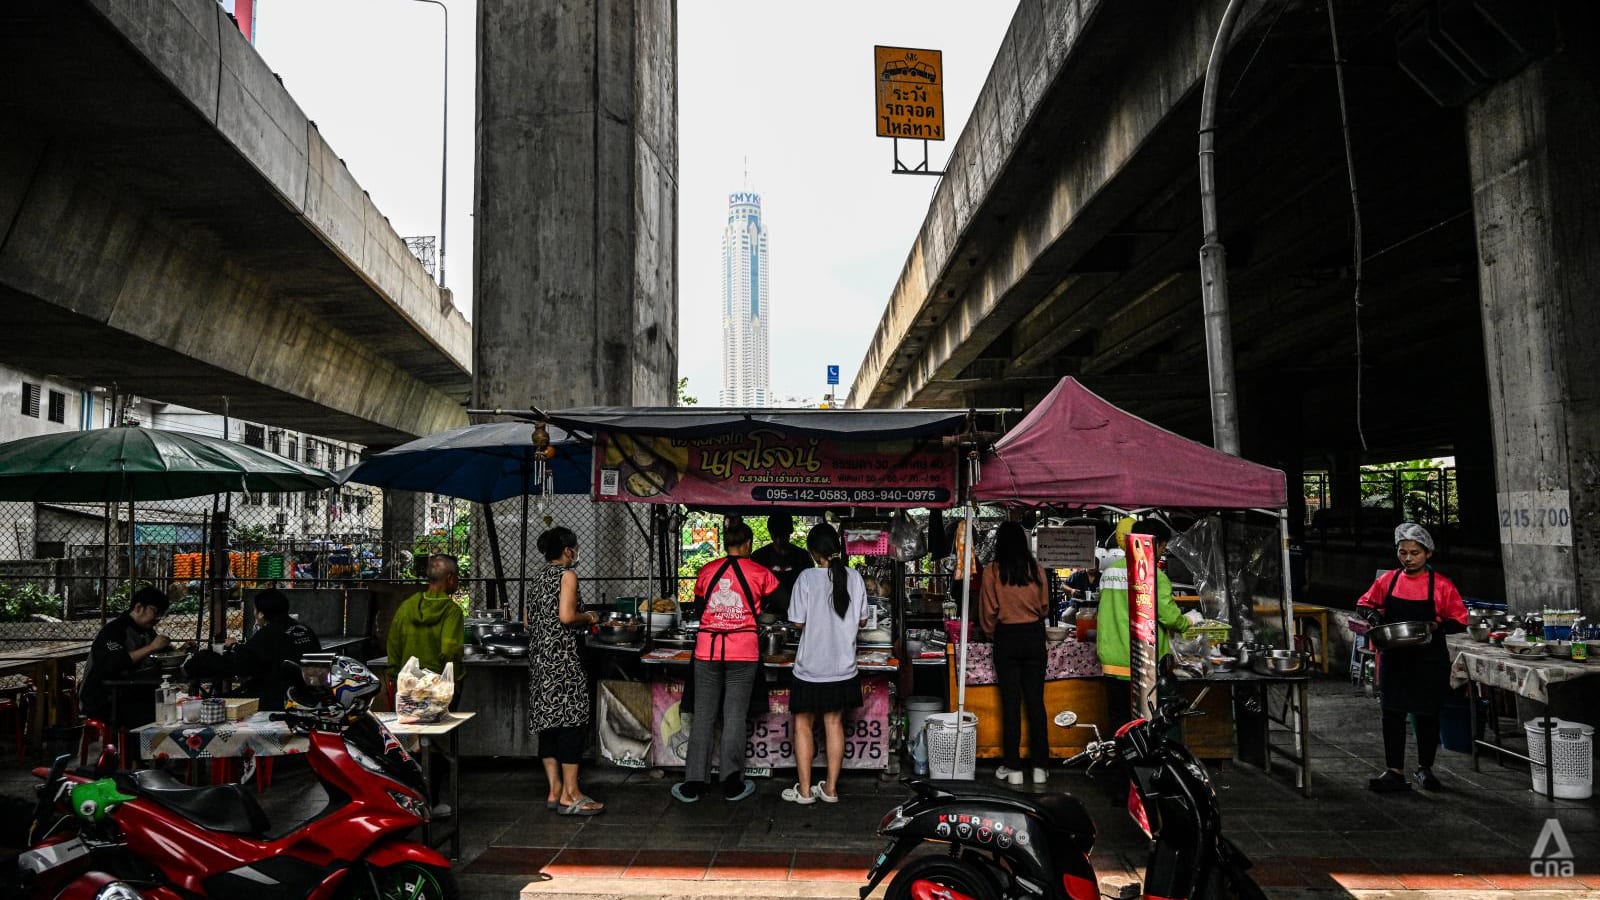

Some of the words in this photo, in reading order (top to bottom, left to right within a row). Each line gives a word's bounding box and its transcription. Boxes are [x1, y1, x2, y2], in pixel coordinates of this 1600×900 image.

[893, 86, 927, 101] ระวัง
[886, 103, 935, 117] รถจอด
[881, 116, 941, 137] ไหล่ทาง
[853, 489, 936, 501] 083-940-0975
